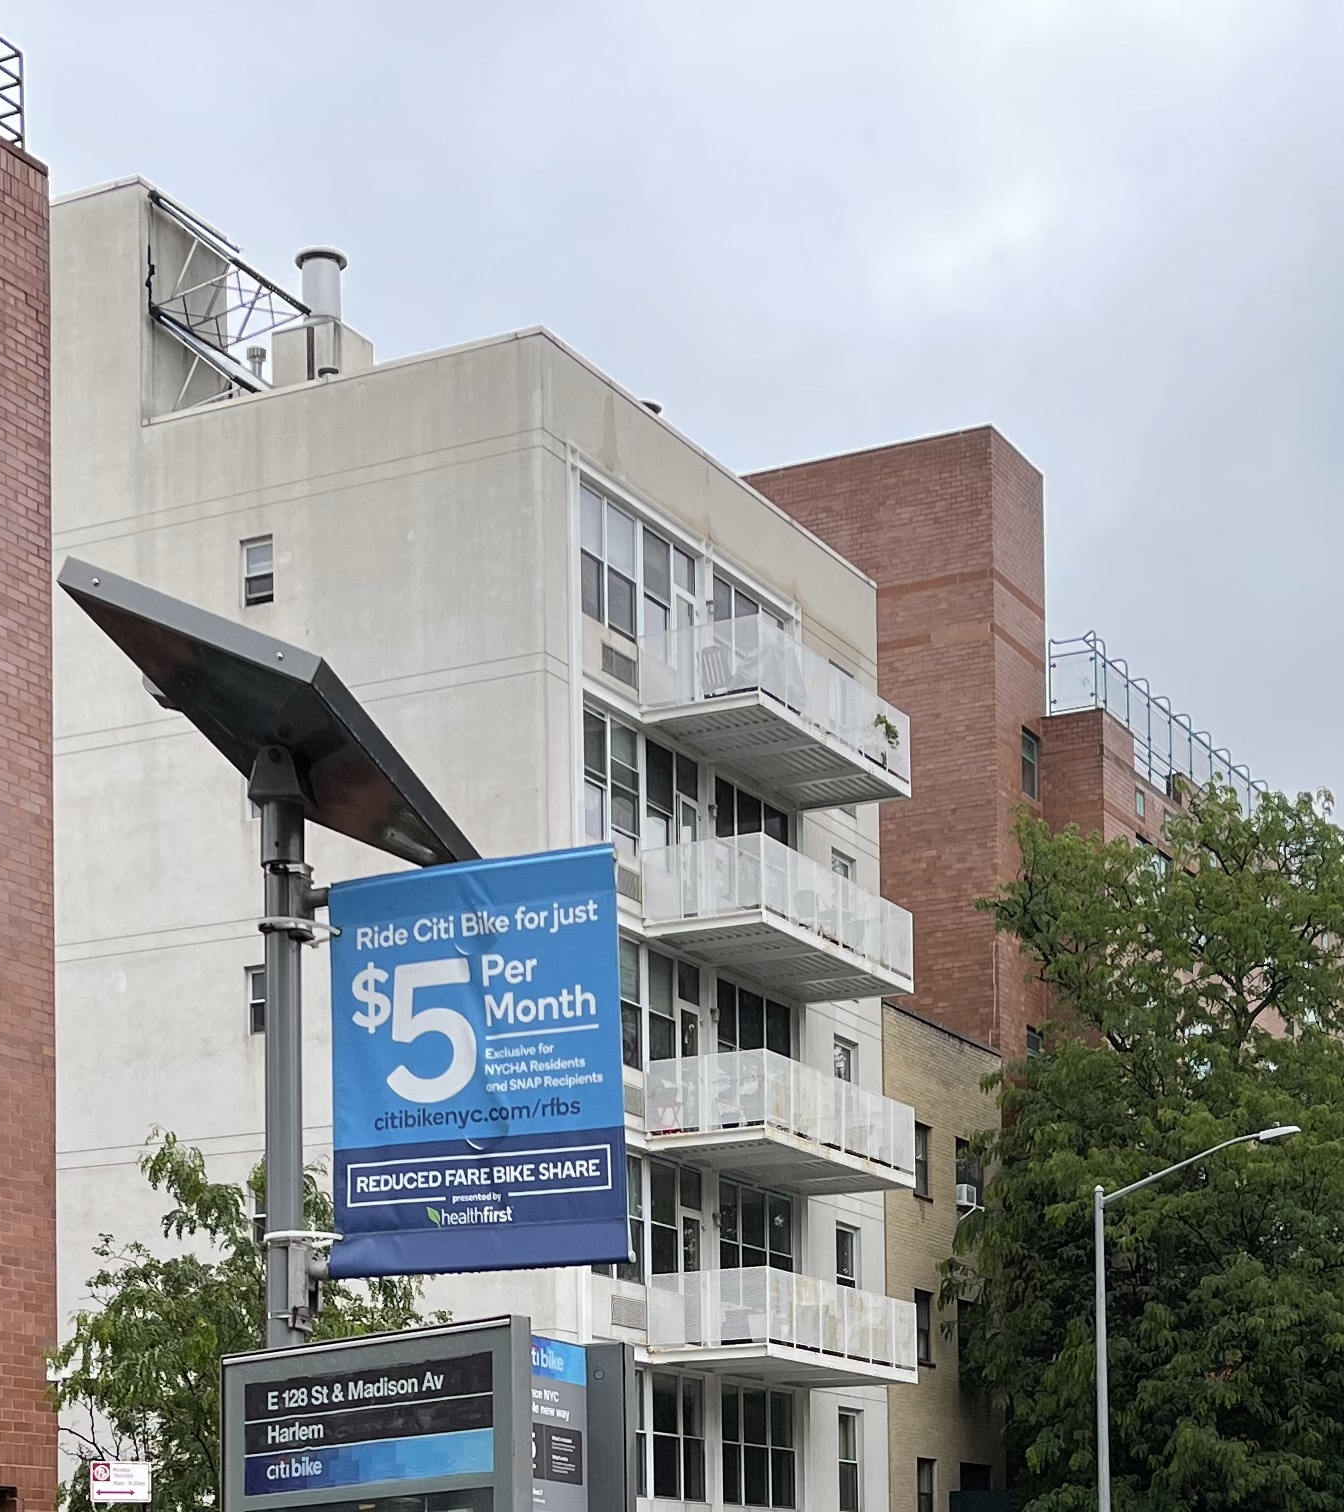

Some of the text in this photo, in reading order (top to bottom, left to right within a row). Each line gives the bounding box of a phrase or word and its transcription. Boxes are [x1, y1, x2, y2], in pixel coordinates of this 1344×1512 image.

[356, 899, 598, 951] Ride Citi Bike for just
[481, 953, 538, 987] Per
[484, 984, 597, 1027] Month
[351, 957, 477, 1104] $5
[485, 1042, 554, 1060] Exclusive for
[484, 1057, 586, 1076] NYCHA Residents
[485, 1071, 604, 1092] and SNAP Recipients
[374, 1097, 581, 1131] citibikenyc.com/rfbs
[356, 1159, 601, 1193] REDUCED FARE BIKE SHARE
[452, 1192, 502, 1204] presented by
[441, 1206, 513, 1226] healthfirst
[267, 1372, 444, 1411] E 128 St & Madison Av
[544, 1389, 559, 1403] NYC
[556, 1408, 570, 1422] way
[267, 1422, 324, 1444] Harlem
